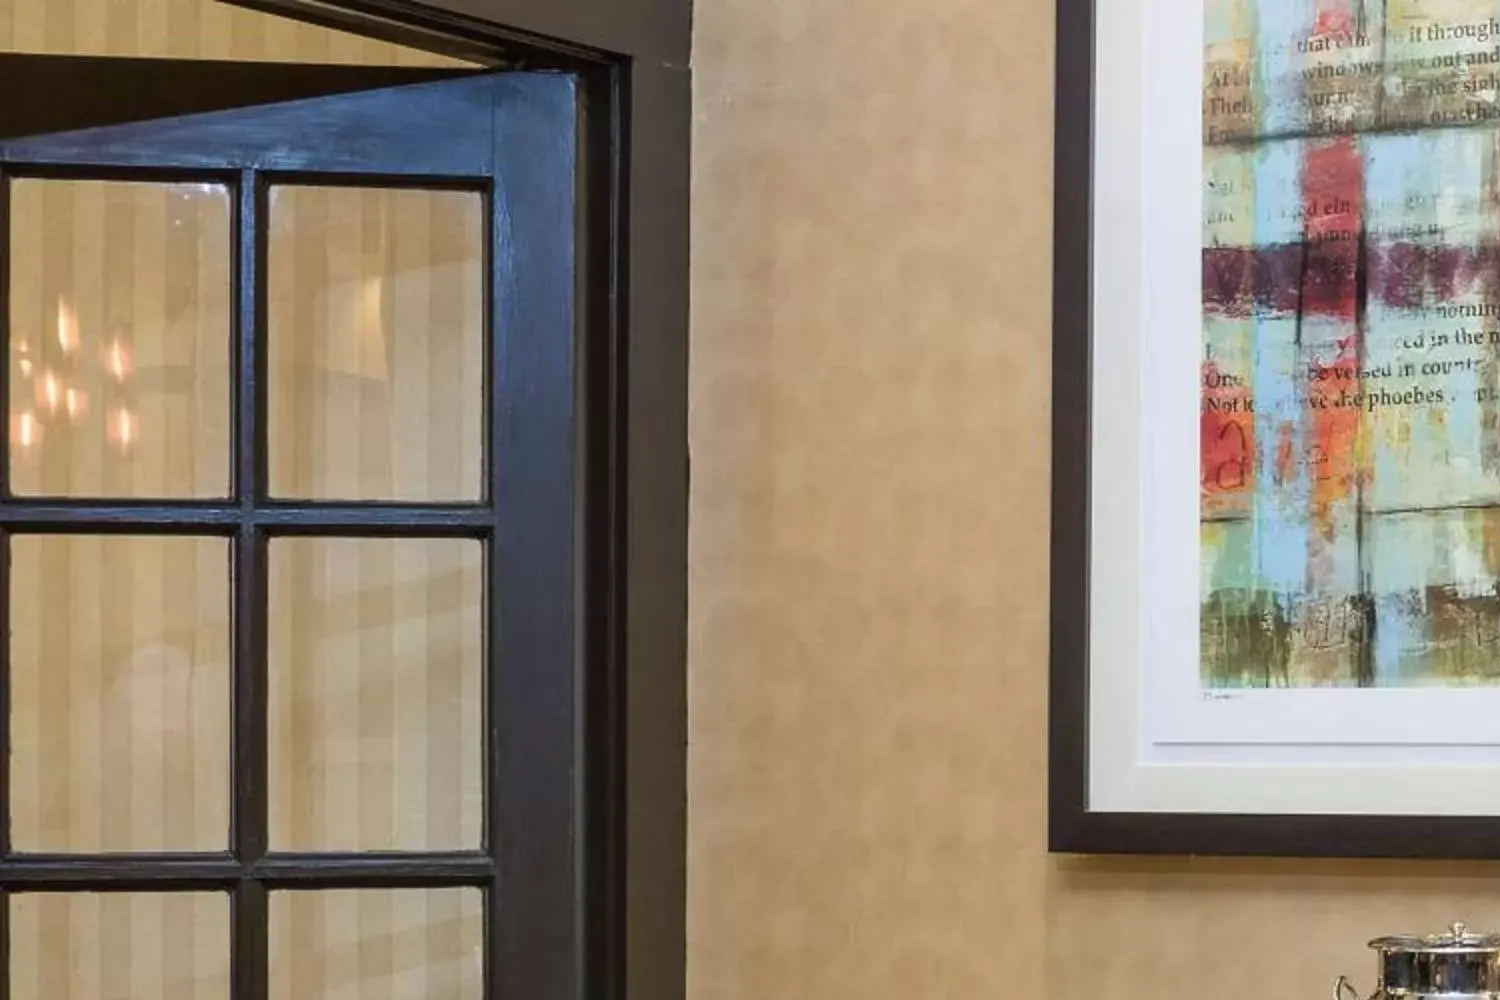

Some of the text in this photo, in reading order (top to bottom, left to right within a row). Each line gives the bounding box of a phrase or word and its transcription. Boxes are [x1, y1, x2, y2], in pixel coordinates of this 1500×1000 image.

[1431, 51, 1461, 69] out
[1454, 328, 1485, 345] the
[1368, 385, 1445, 412] phoebes
